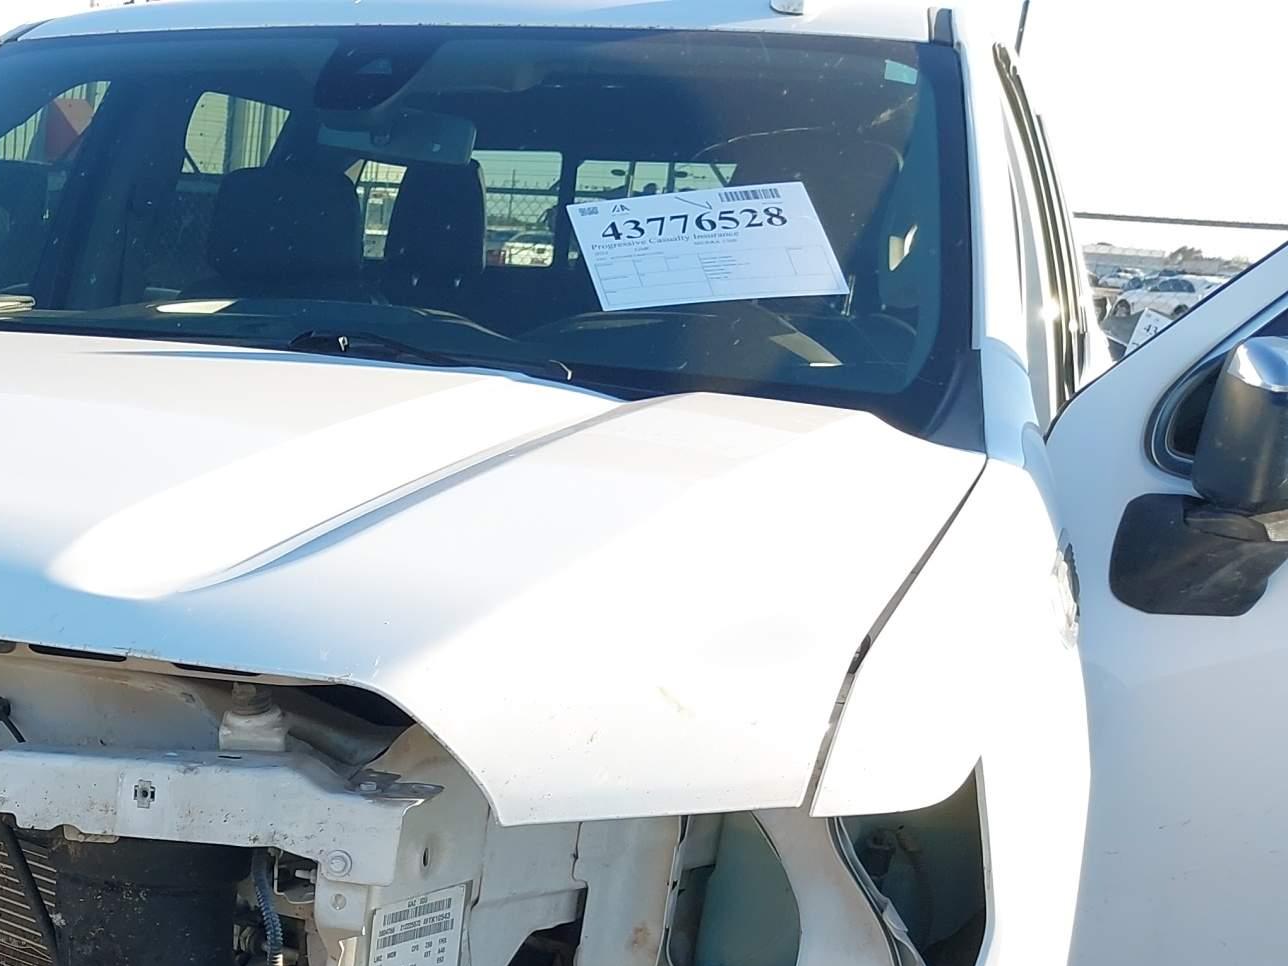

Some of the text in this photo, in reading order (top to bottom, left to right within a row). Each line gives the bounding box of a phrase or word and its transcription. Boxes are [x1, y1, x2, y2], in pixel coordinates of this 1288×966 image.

[601, 206, 788, 241] 43776528
[591, 231, 740, 250] Progressive Casualty Insurance
